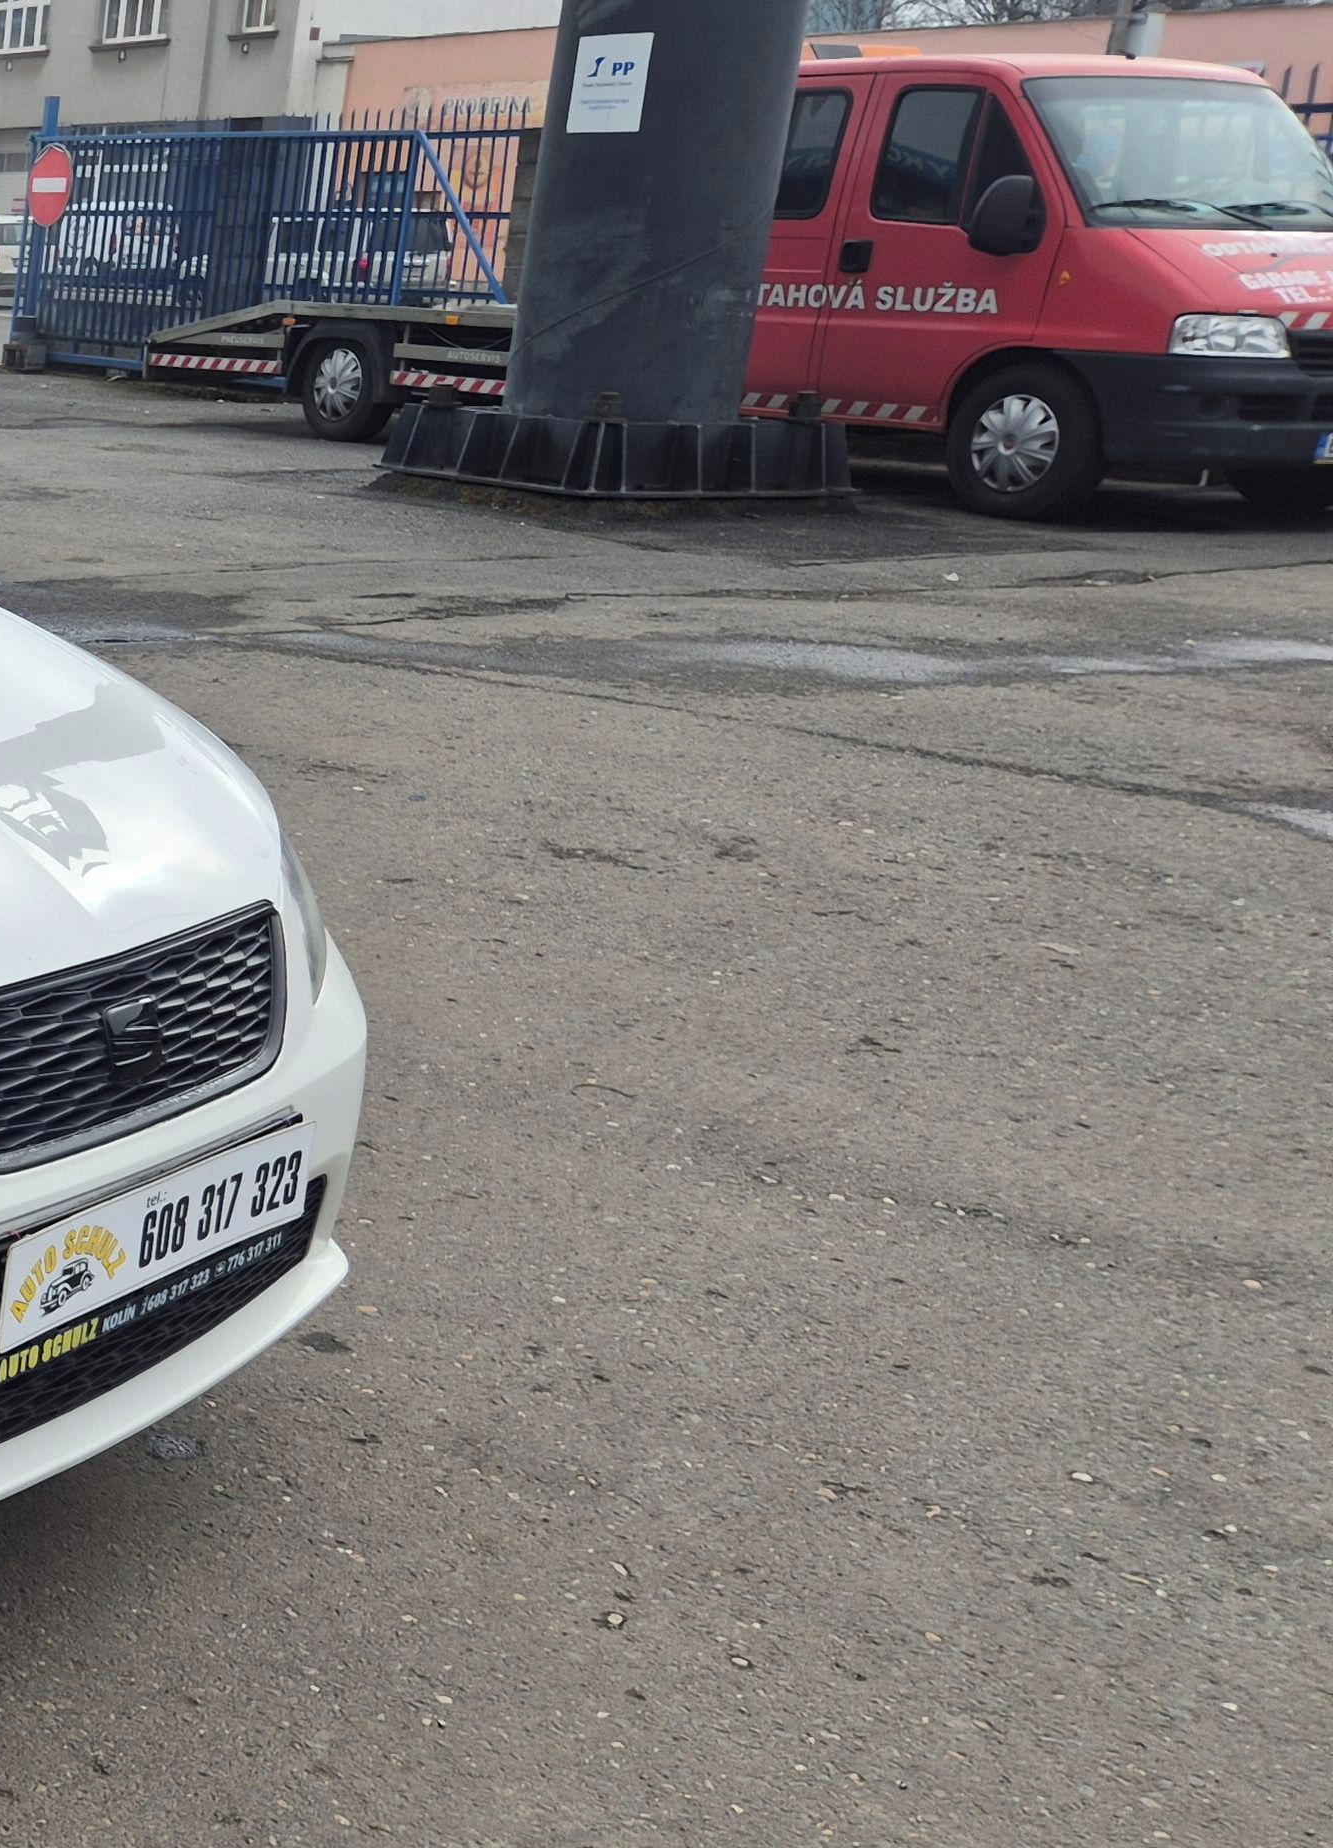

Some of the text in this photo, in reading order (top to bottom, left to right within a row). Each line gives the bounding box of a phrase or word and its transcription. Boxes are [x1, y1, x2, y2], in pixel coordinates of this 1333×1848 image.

[611, 61, 635, 76] PP
[443, 96, 531, 117] PRODEJNA
[875, 282, 999, 314] SLUŽBA
[446, 350, 501, 364] AUTOSERVIS
[138, 1150, 303, 1269] 608 317 323
[10, 1224, 127, 1324] AUTO SCHULZ
[41, 1316, 100, 1363] SCHULZ
[101, 1302, 137, 1334] KOLÍN
[169, 1278, 191, 1300] 317
[190, 1268, 211, 1291] 323
[226, 1249, 246, 1273] 776
[246, 1240, 265, 1262] 317
[264, 1231, 282, 1252] 311
